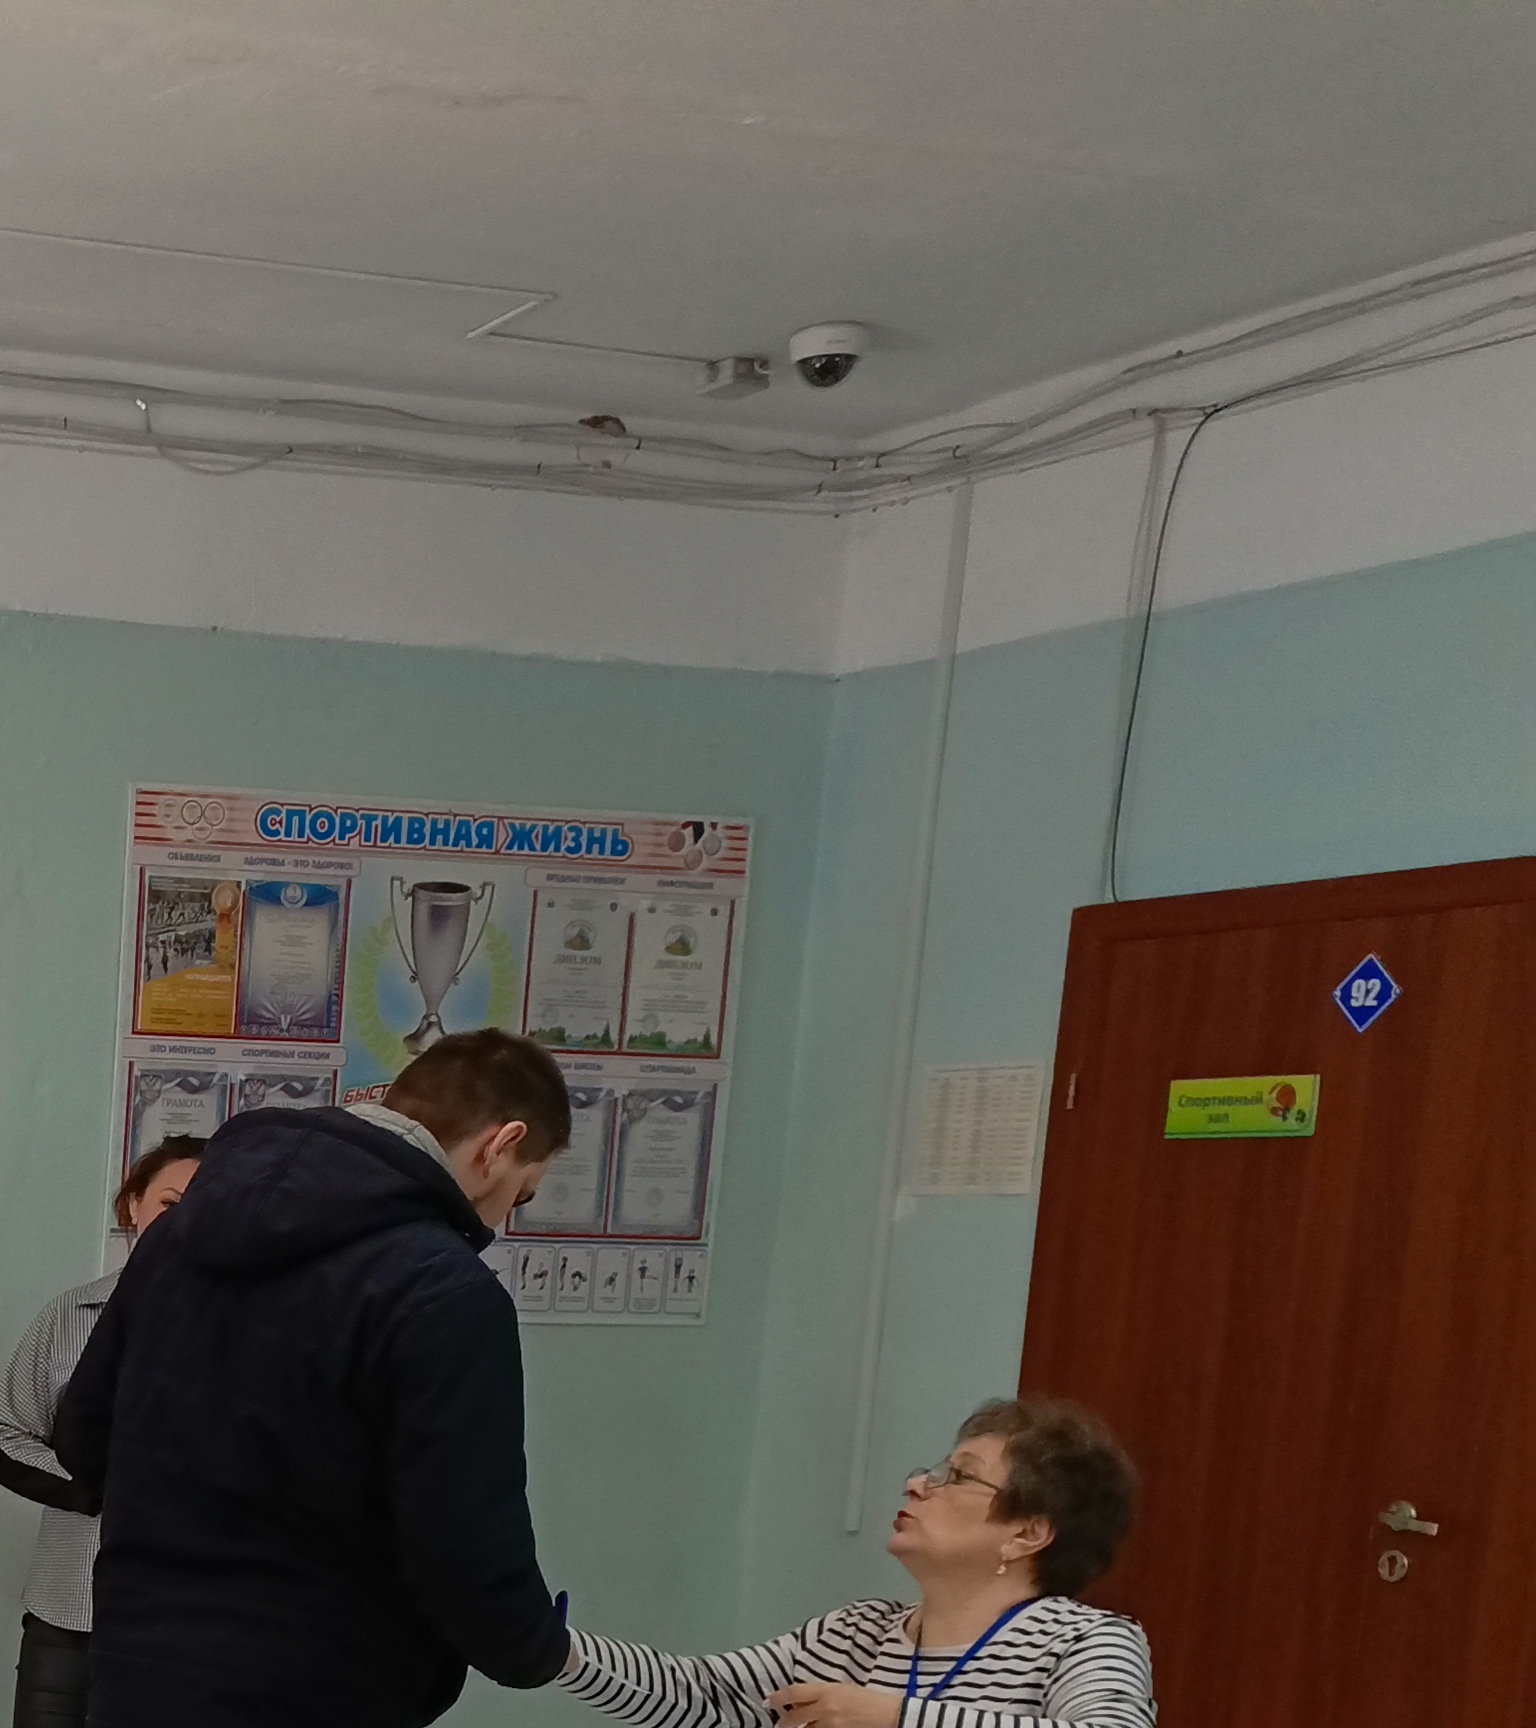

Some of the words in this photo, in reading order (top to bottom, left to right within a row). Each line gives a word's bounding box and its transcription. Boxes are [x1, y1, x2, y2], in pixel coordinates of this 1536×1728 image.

[257, 804, 496, 852] СПОРТИВНАЯ
[504, 818, 633, 859] ЖИЗНЬ
[1350, 978, 1381, 1008] 92
[1177, 1090, 1263, 1110] Спортивный
[1206, 1111, 1230, 1125] зал
